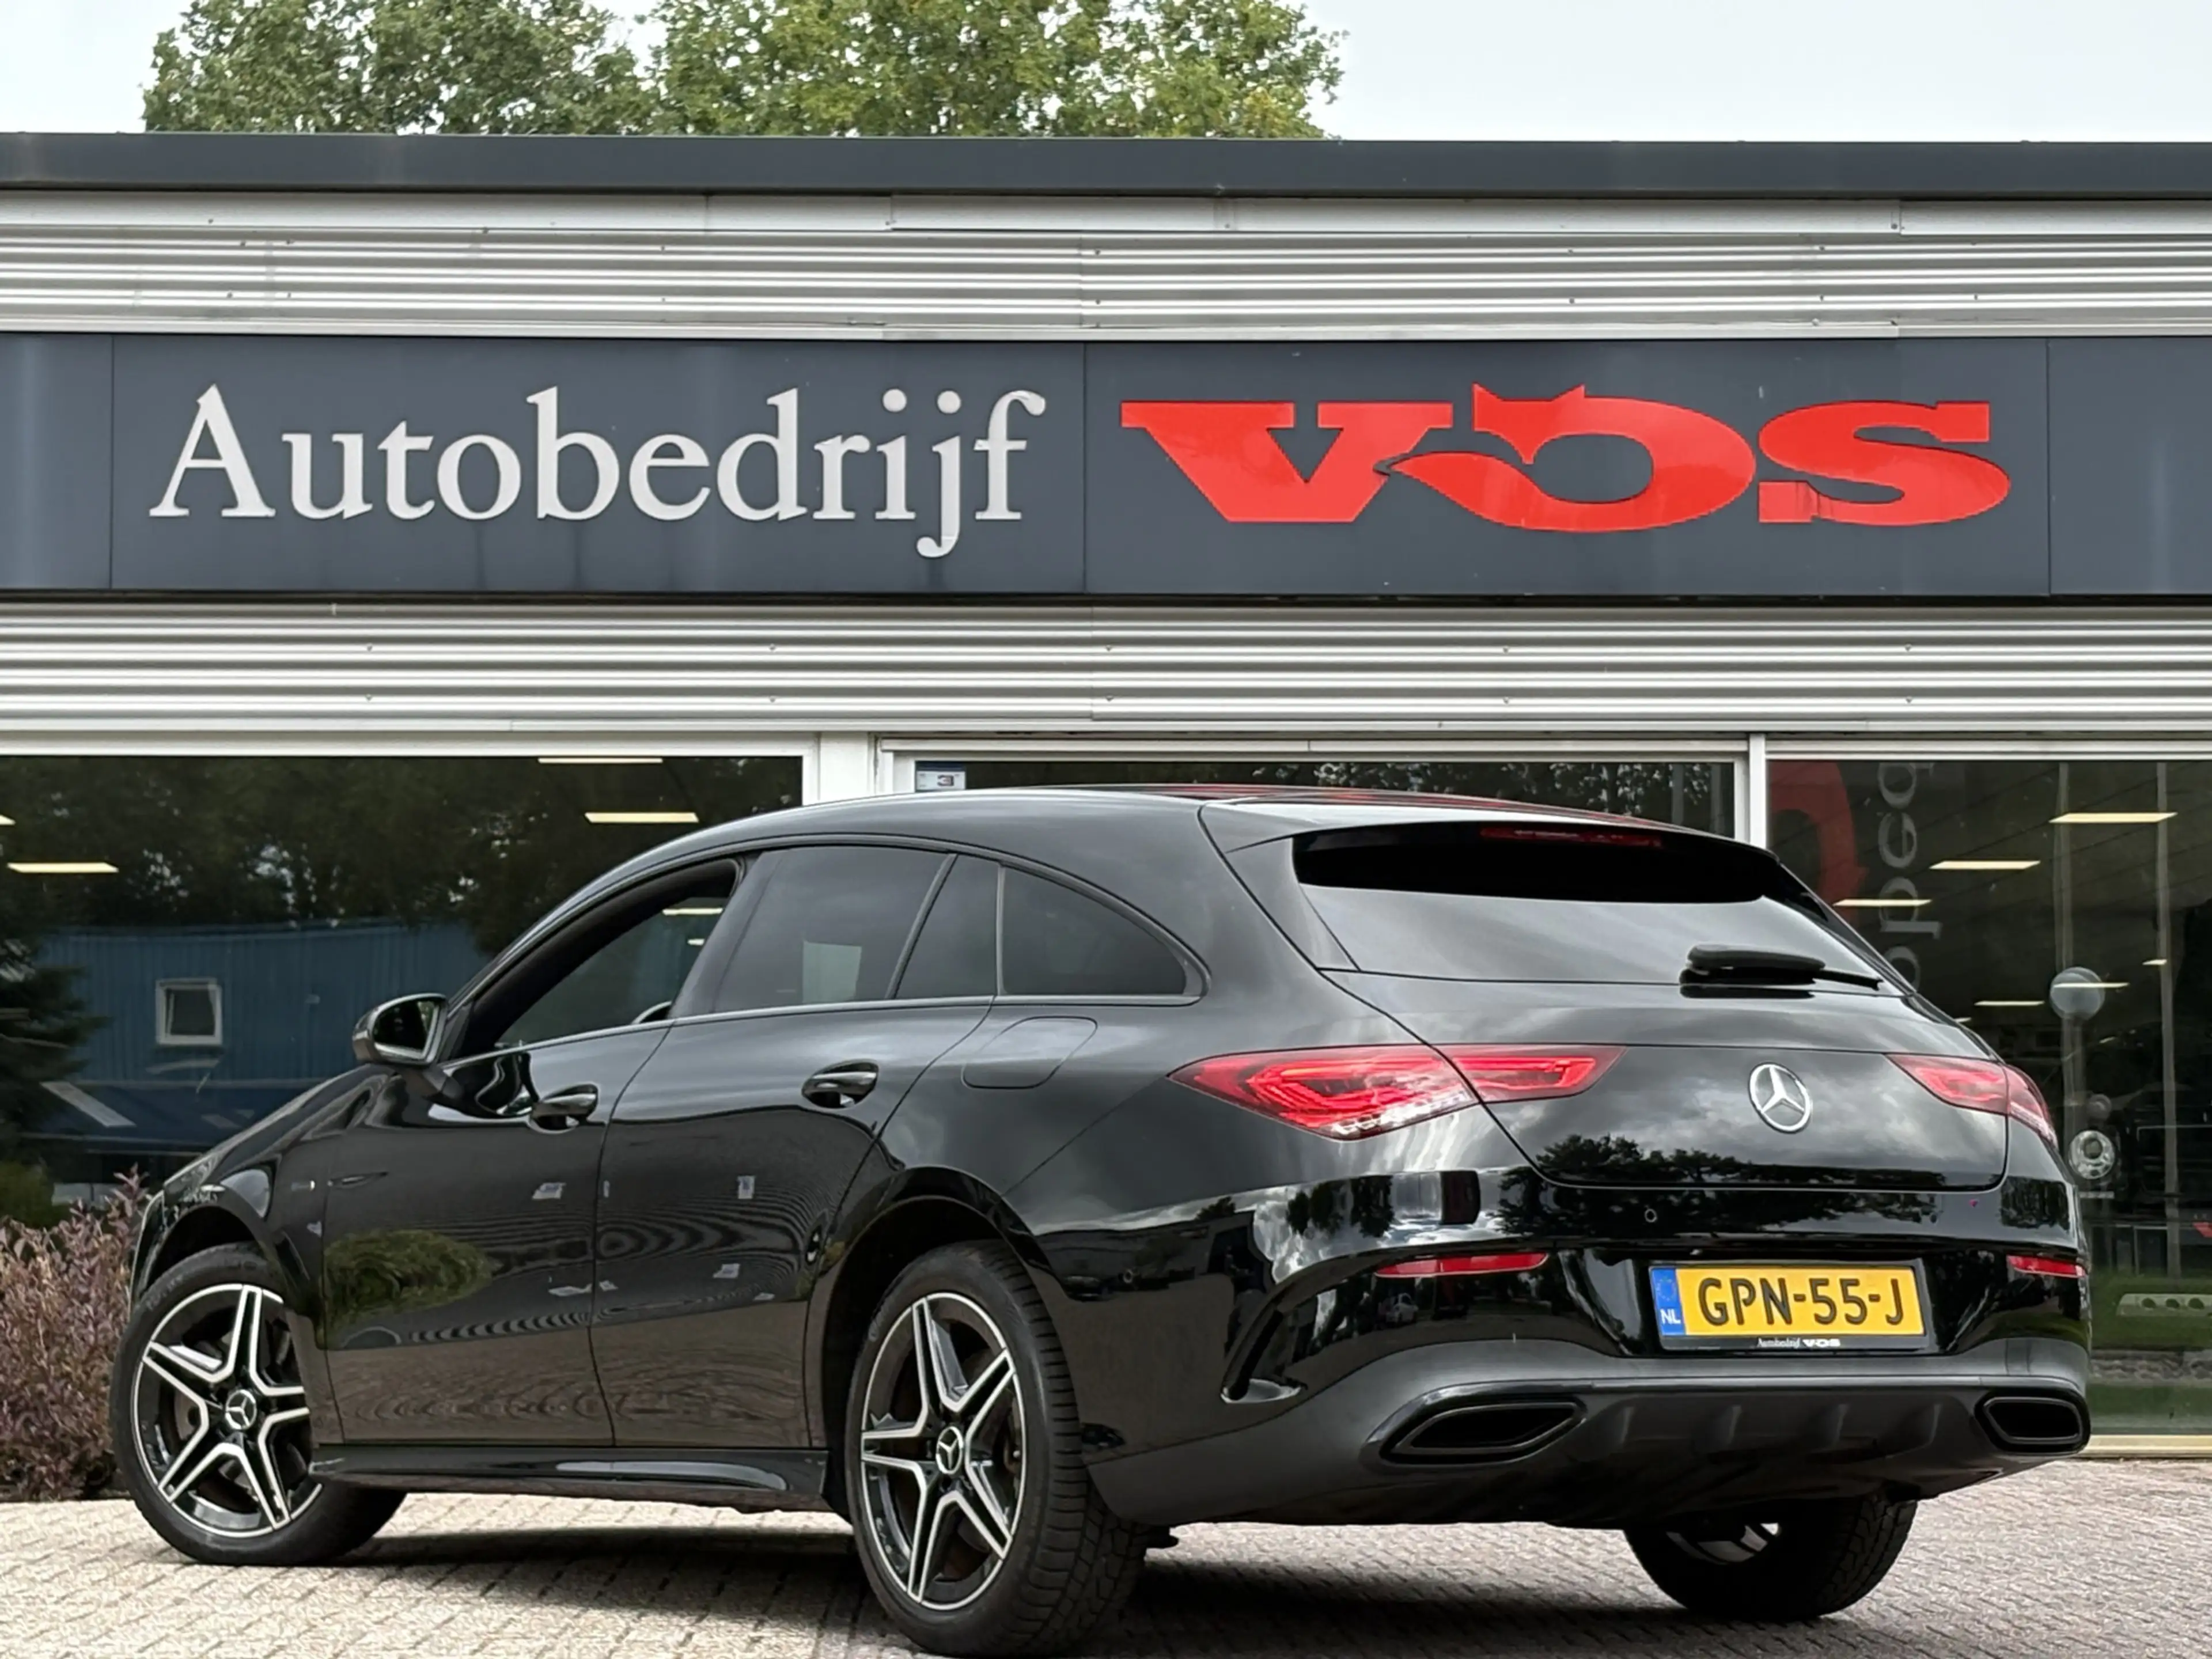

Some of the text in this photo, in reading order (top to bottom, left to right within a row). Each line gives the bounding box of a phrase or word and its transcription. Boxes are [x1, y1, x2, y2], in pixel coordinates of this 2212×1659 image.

[150, 383, 2010, 558] Autobedrijf VOS
[1660, 1309, 1681, 1324] NL
[1698, 1278, 1903, 1326] GPN-55-J
